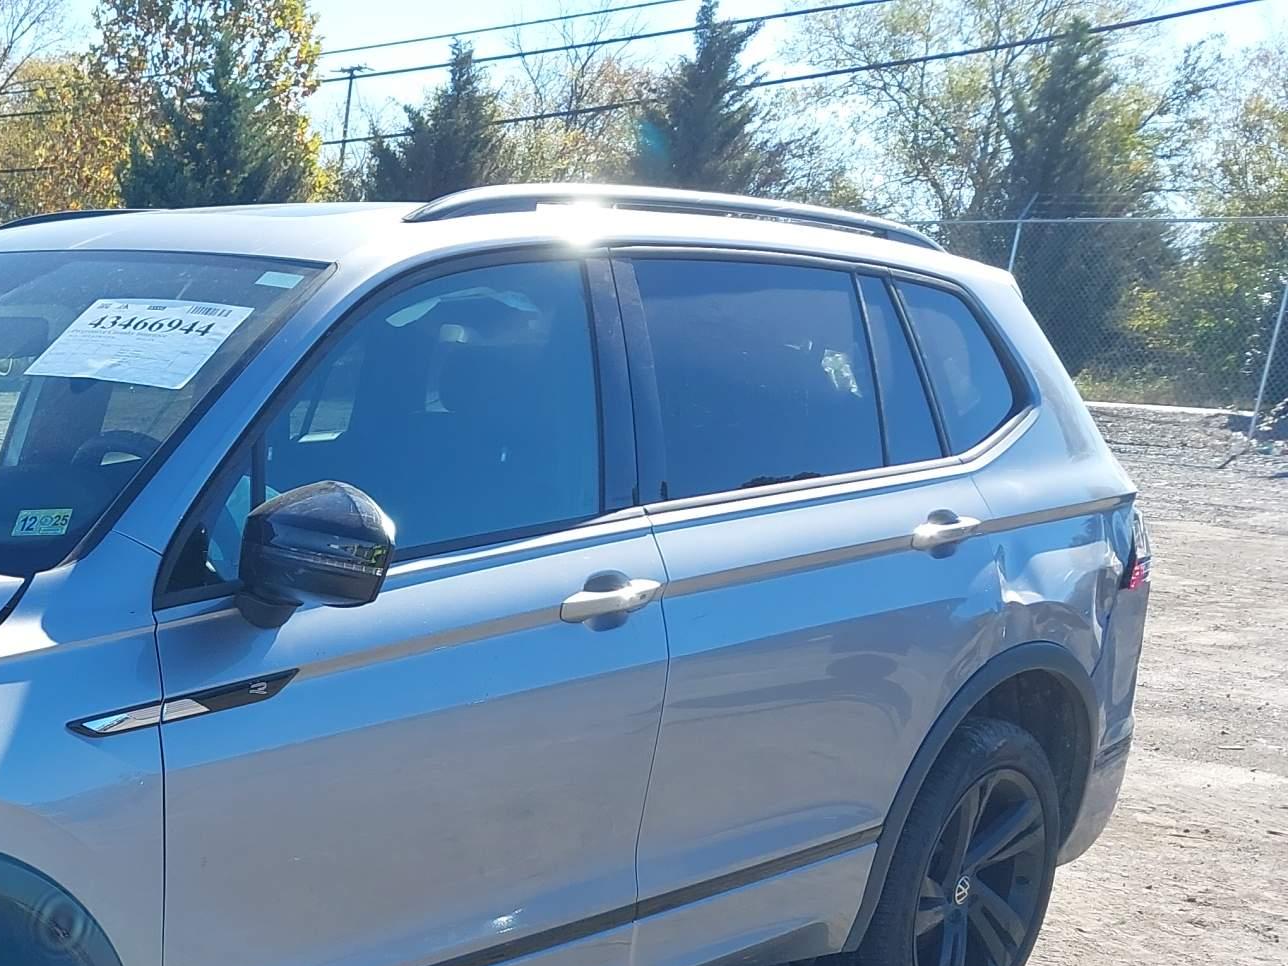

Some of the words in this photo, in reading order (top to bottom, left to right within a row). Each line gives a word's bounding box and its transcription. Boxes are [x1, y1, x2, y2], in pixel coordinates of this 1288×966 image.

[87, 315, 216, 336] 43466944
[20, 515, 38, 532] 12
[52, 514, 69, 526] 25
